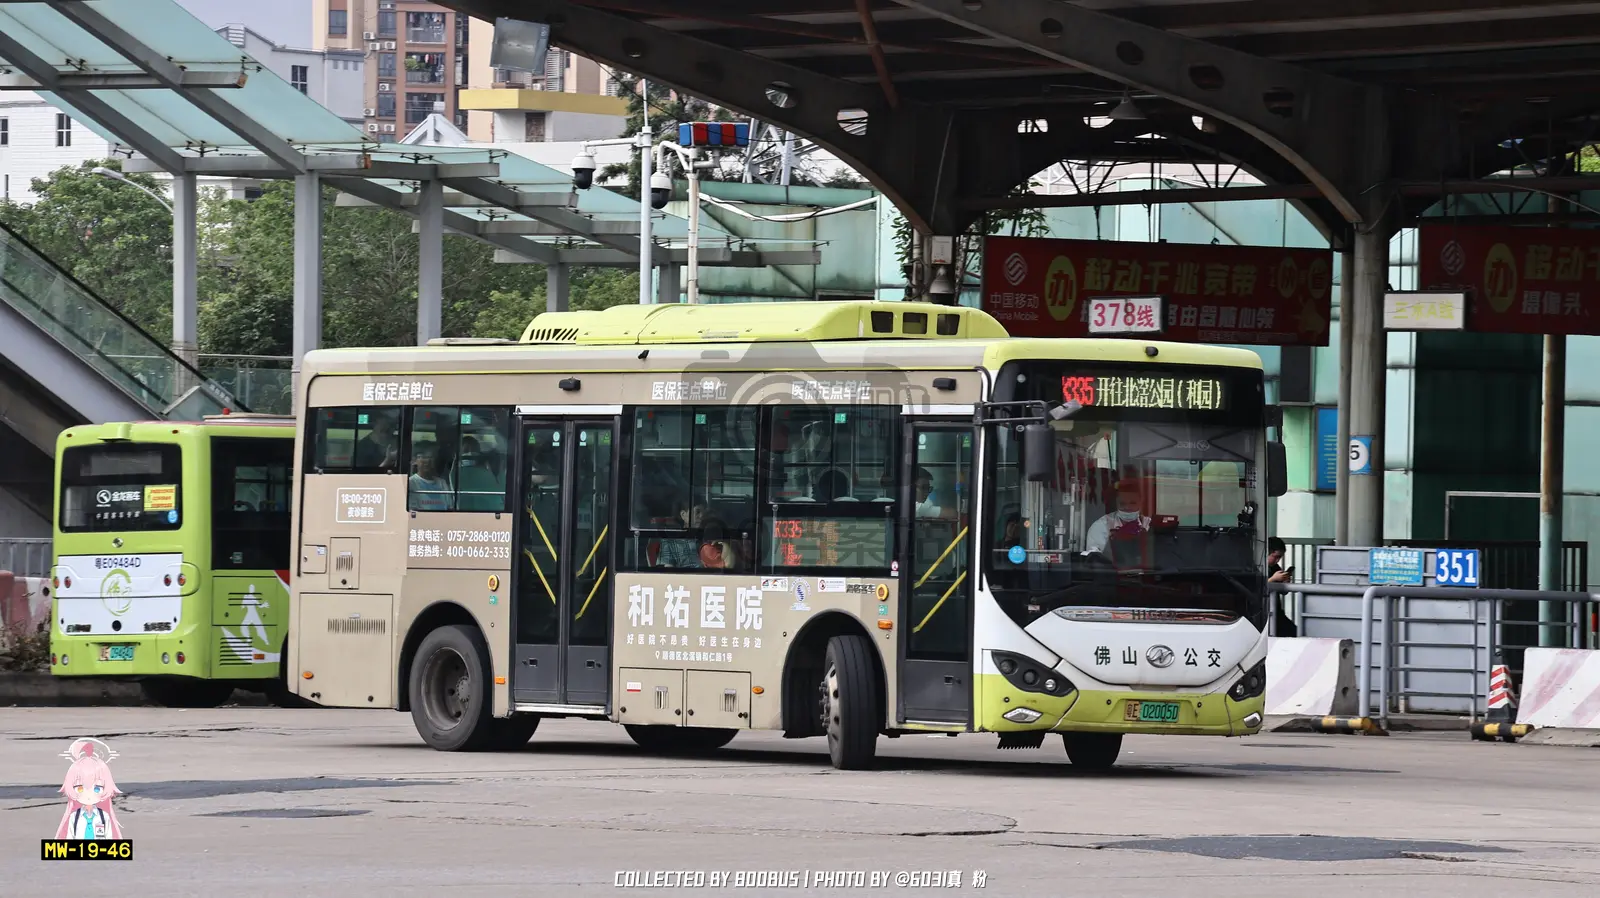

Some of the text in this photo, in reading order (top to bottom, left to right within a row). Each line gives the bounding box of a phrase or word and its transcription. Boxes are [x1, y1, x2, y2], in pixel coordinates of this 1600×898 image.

[1082, 257, 1258, 297] 移动千兆宽带
[1048, 270, 1074, 307] 办
[989, 292, 1040, 309] 中国移动
[991, 310, 1039, 321] China Mobile
[1093, 302, 1155, 328] 378线
[1393, 301, 1455, 321] 三水A线
[362, 382, 434, 401] 医保定点单位
[651, 380, 728, 401] 医保定点单位
[790, 380, 872, 401] 医保定点单位
[341, 493, 382, 504] 18:00-21:00
[774, 519, 802, 538] K335
[95, 557, 142, 569] 粤E09484D
[1436, 551, 1477, 583] 351
[628, 584, 763, 630] 和祐医院
[626, 633, 762, 649] 好医院不昂贵 好医生在身边
